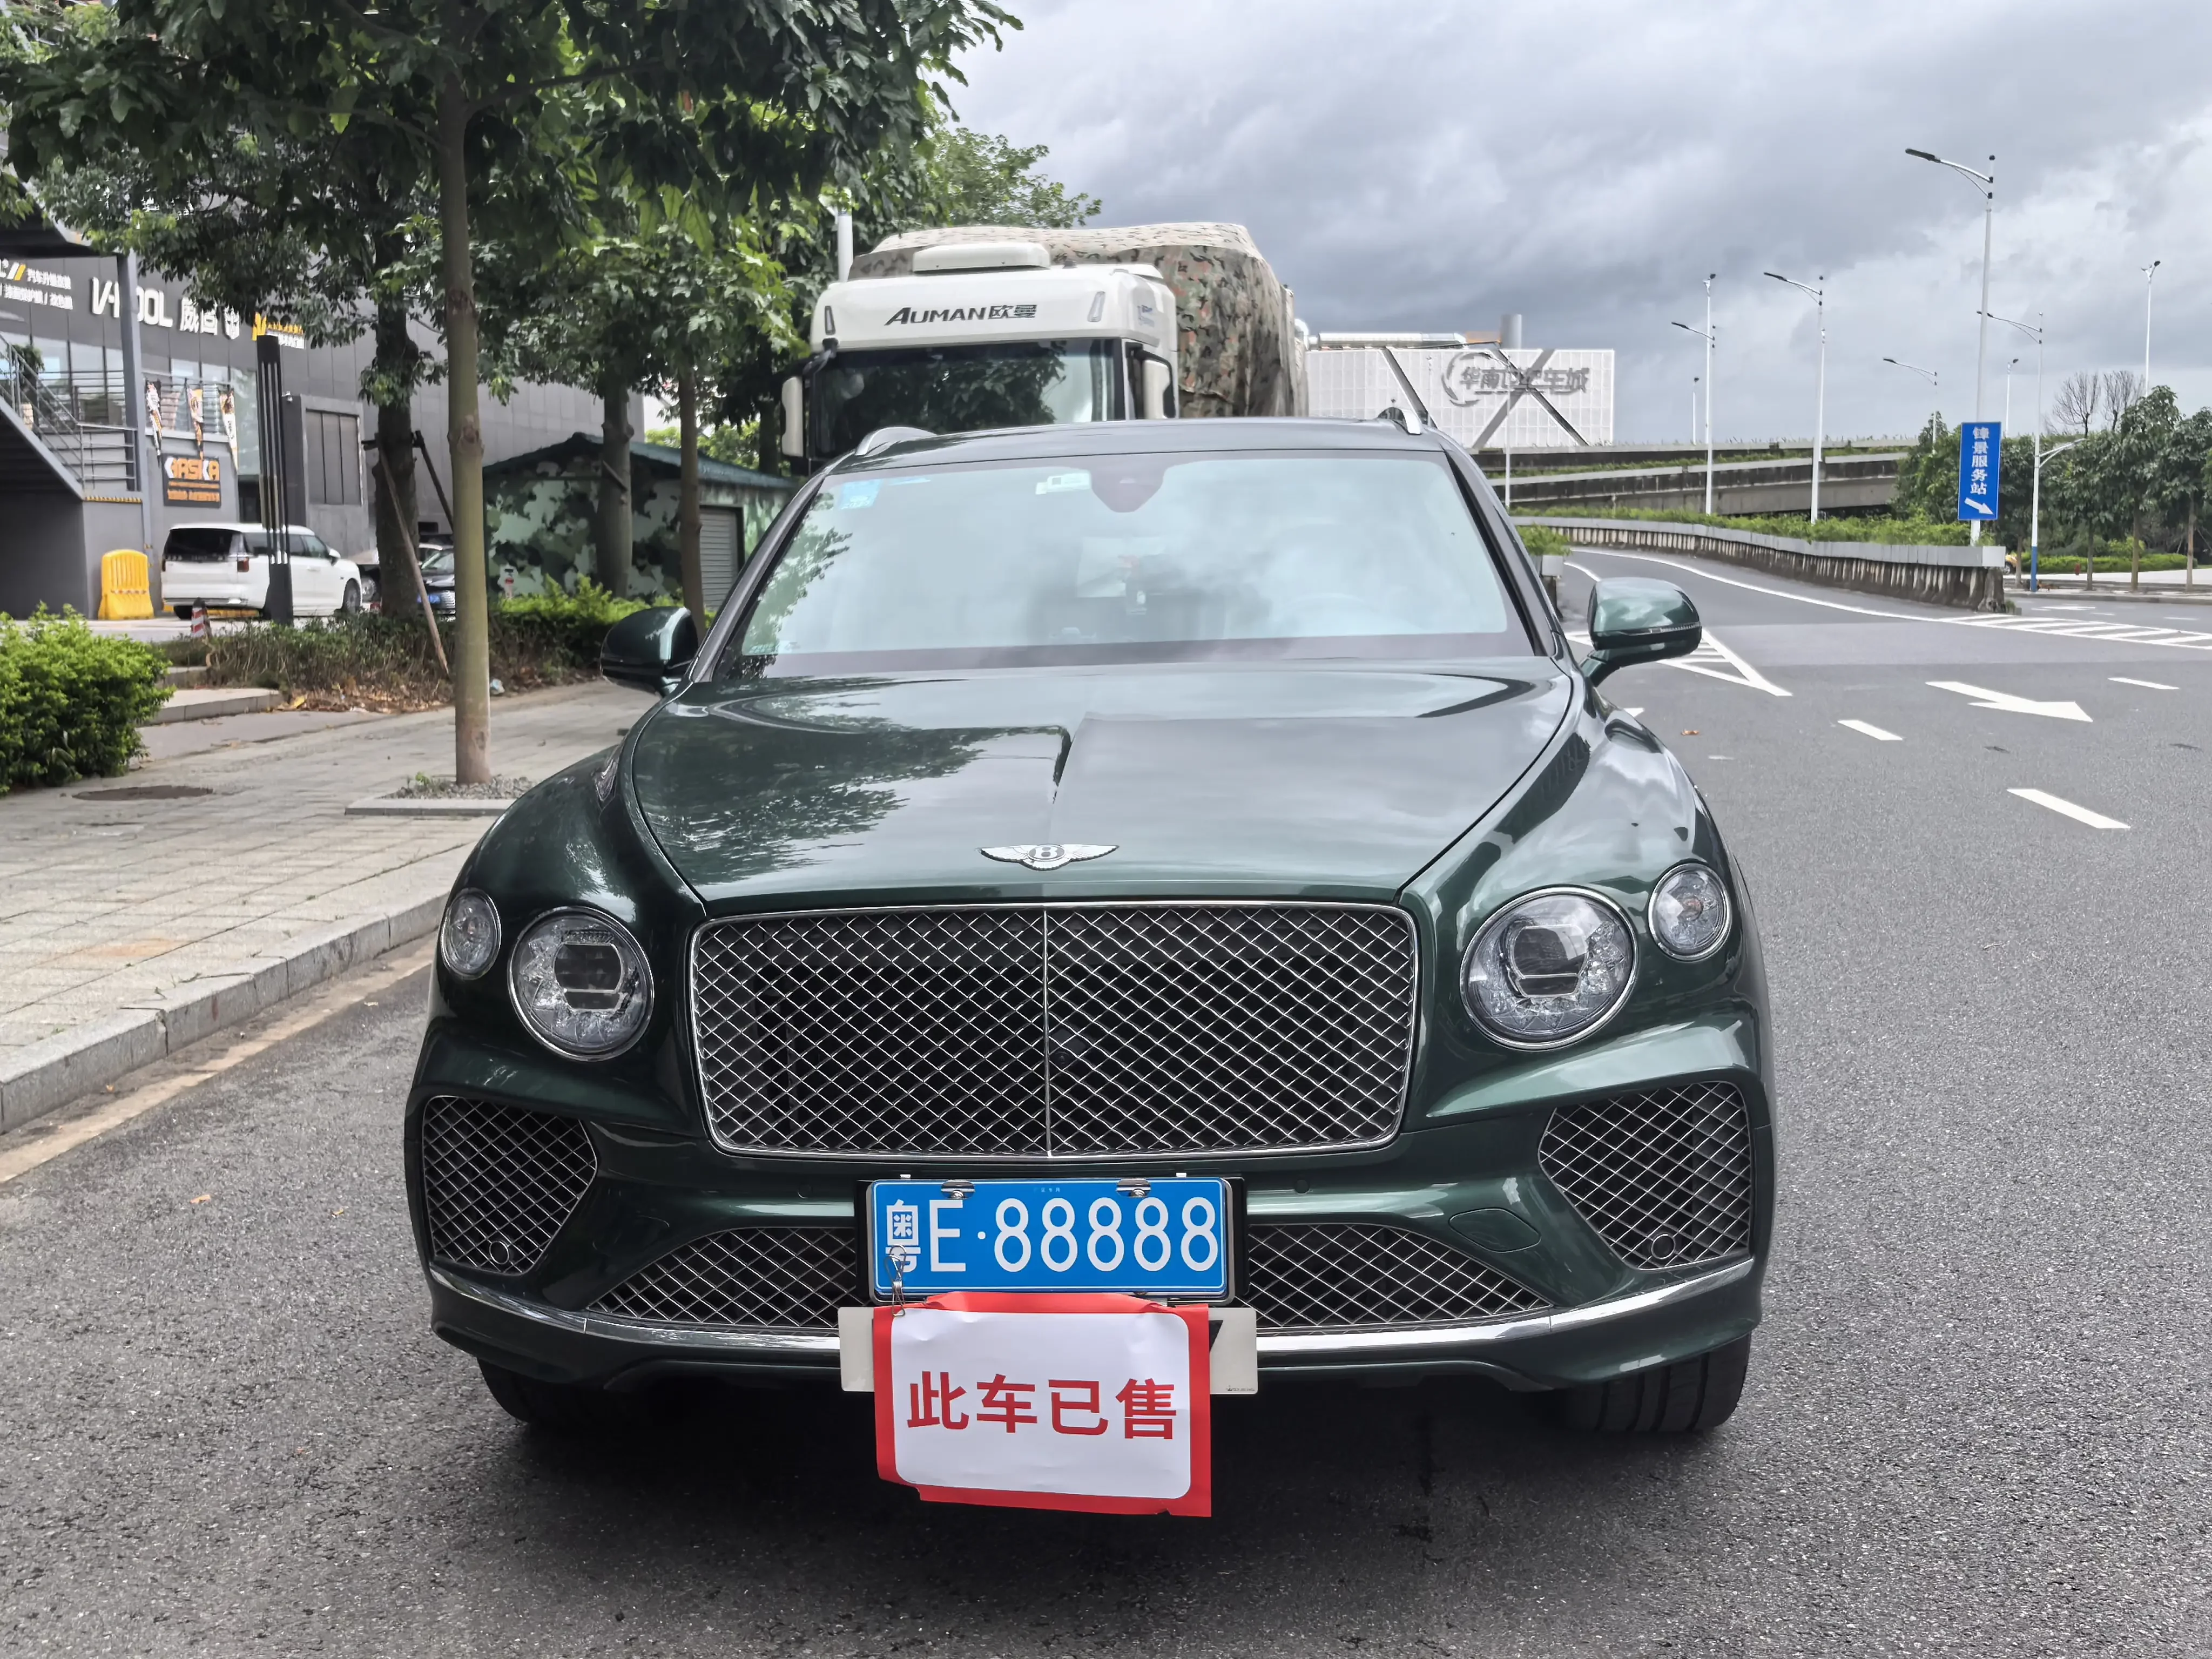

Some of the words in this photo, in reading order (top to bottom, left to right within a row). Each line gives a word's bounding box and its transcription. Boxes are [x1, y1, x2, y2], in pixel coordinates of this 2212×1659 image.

[884, 307, 987, 326] AUMAN
[907, 1371, 1177, 1440] 此车已售
